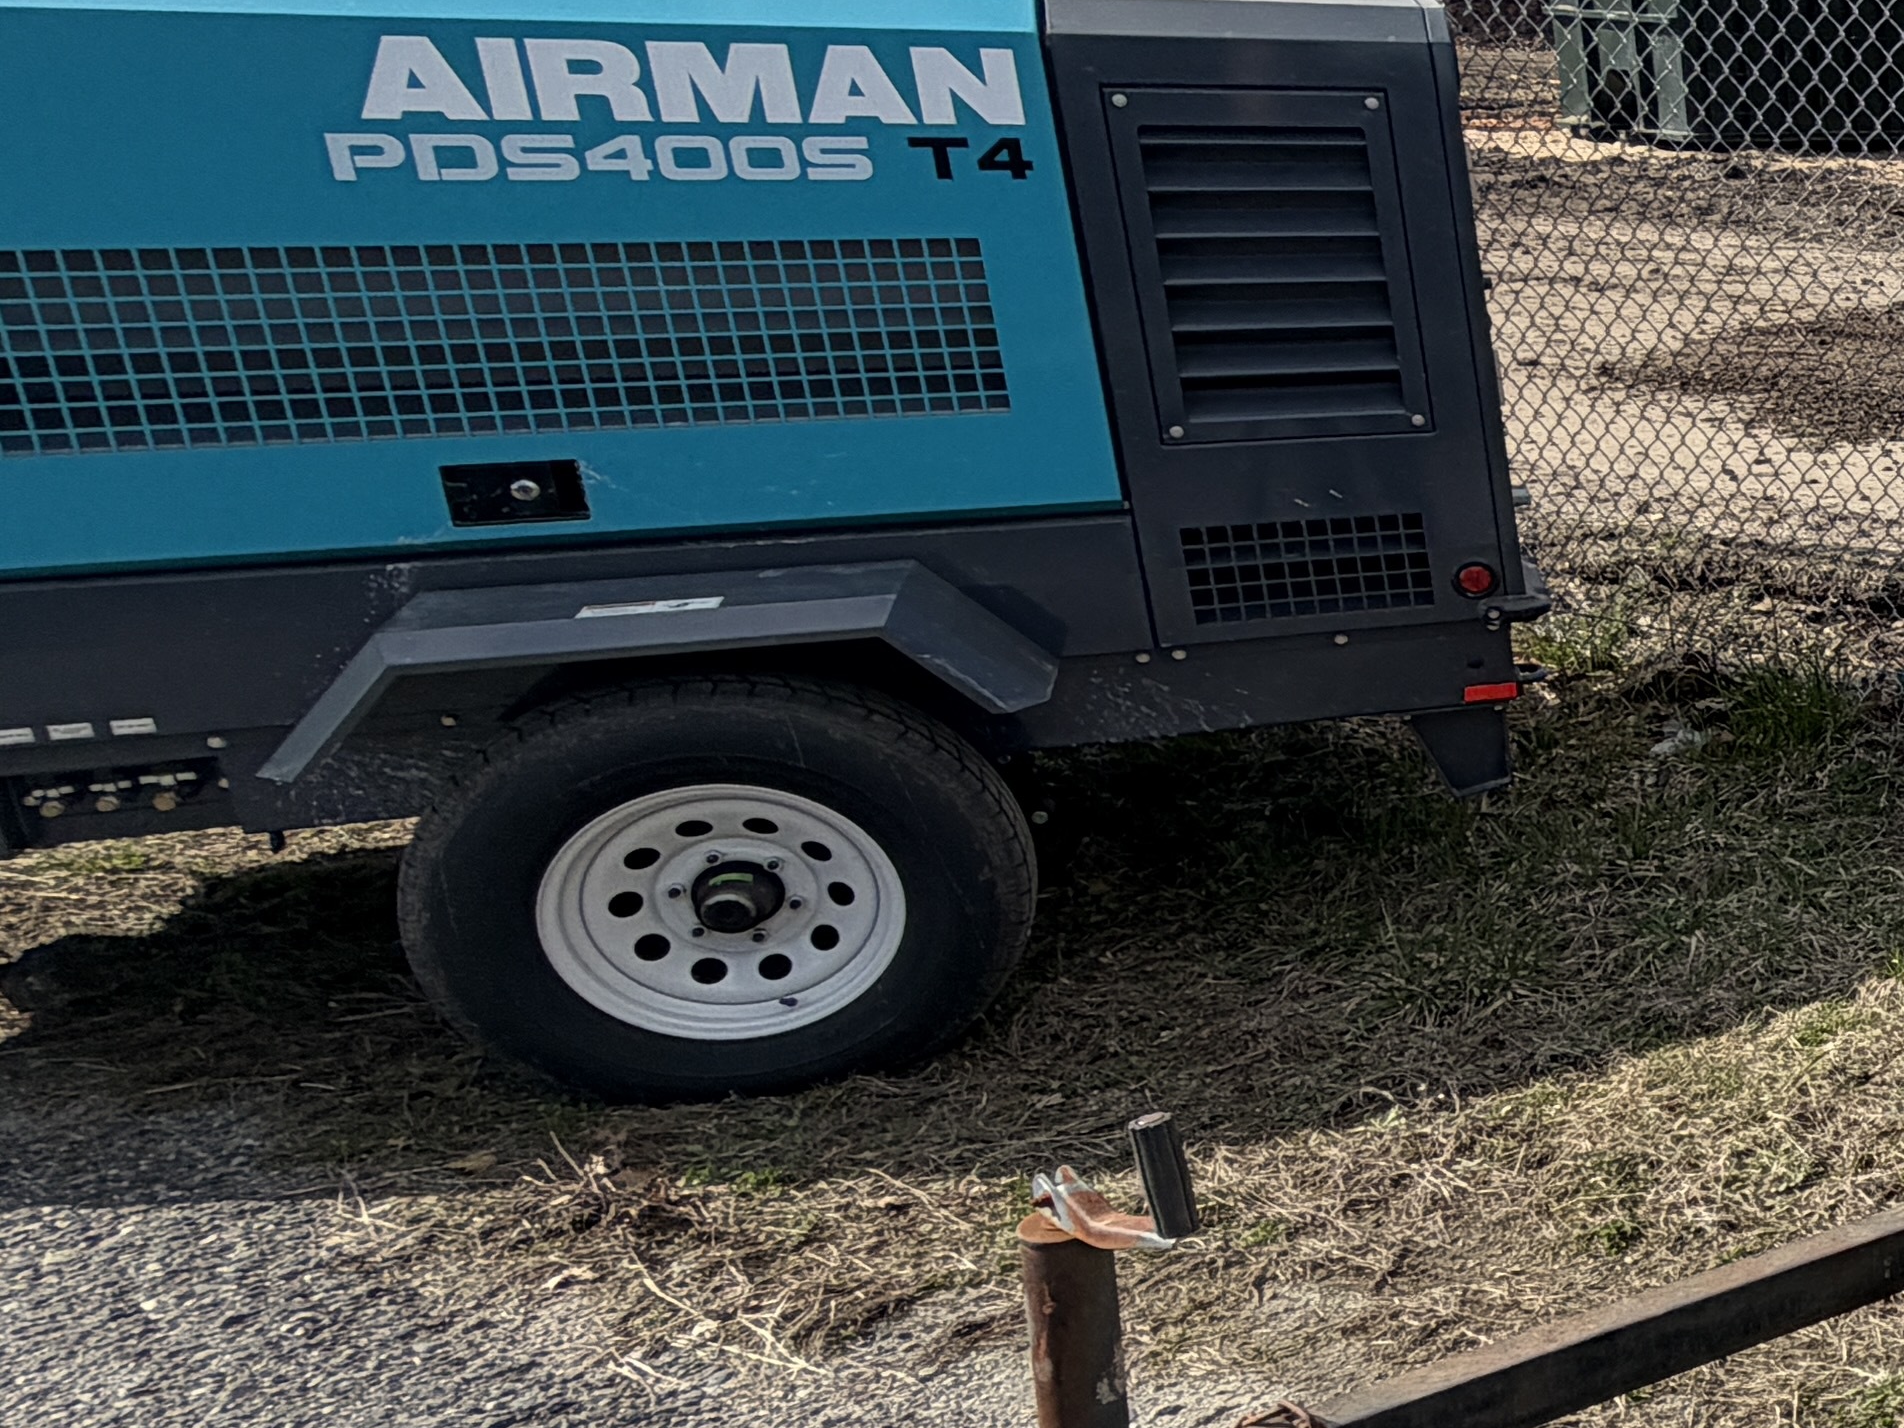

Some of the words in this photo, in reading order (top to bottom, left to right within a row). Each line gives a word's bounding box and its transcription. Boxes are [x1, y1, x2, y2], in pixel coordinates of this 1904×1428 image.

[361, 35, 1027, 126] AIRMAN
[323, 133, 873, 181] PDS400S
[907, 137, 1034, 181] T4
